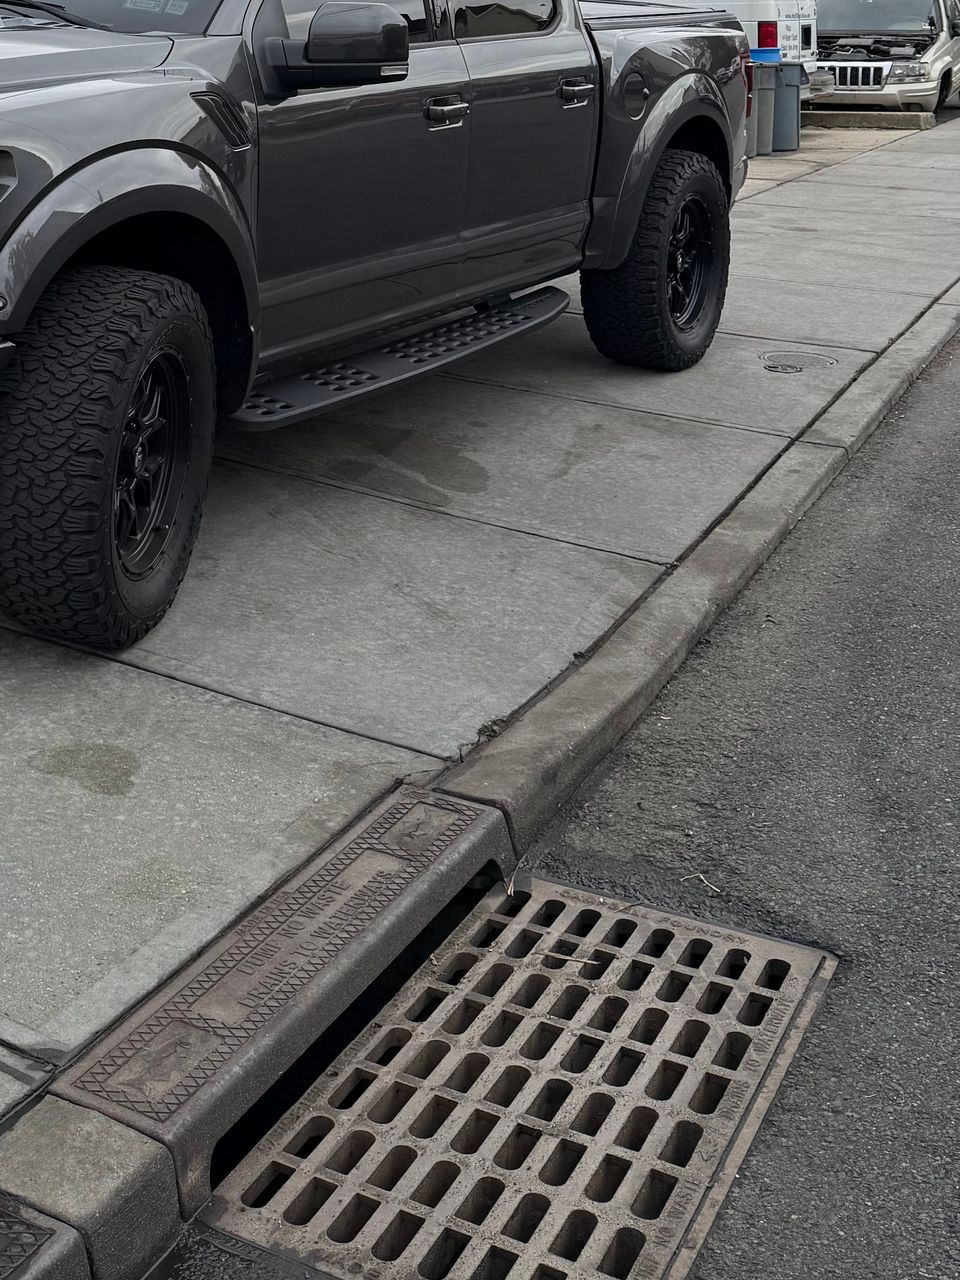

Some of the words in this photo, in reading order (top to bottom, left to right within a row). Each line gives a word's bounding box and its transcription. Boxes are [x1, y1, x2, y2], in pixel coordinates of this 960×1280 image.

[276, 920, 306, 939] NO
[297, 879, 352, 920] WASTE
[658, 917, 750, 945] FOUNDRY
[237, 959, 299, 1009] DRAINS
[289, 941, 319, 958] TO
[309, 871, 395, 940] WATERWAYS
[742, 1058, 761, 1073] TO
